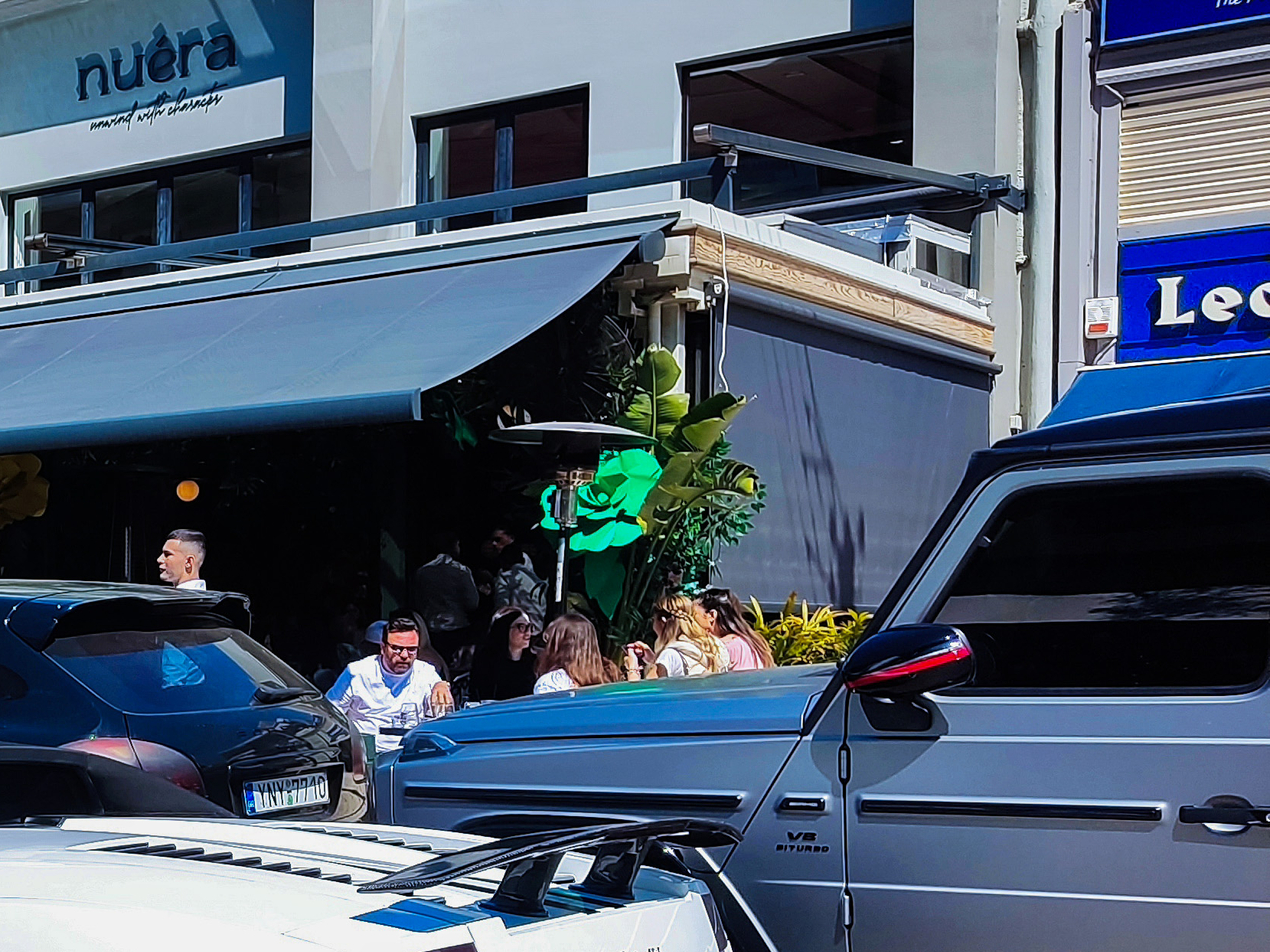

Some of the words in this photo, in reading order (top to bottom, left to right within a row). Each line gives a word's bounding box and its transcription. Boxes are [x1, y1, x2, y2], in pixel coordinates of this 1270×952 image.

[77, 33, 238, 101] nuéra
[136, 90, 171, 126] with
[786, 831, 818, 841] V8
[775, 844, 830, 853] BITURBO
